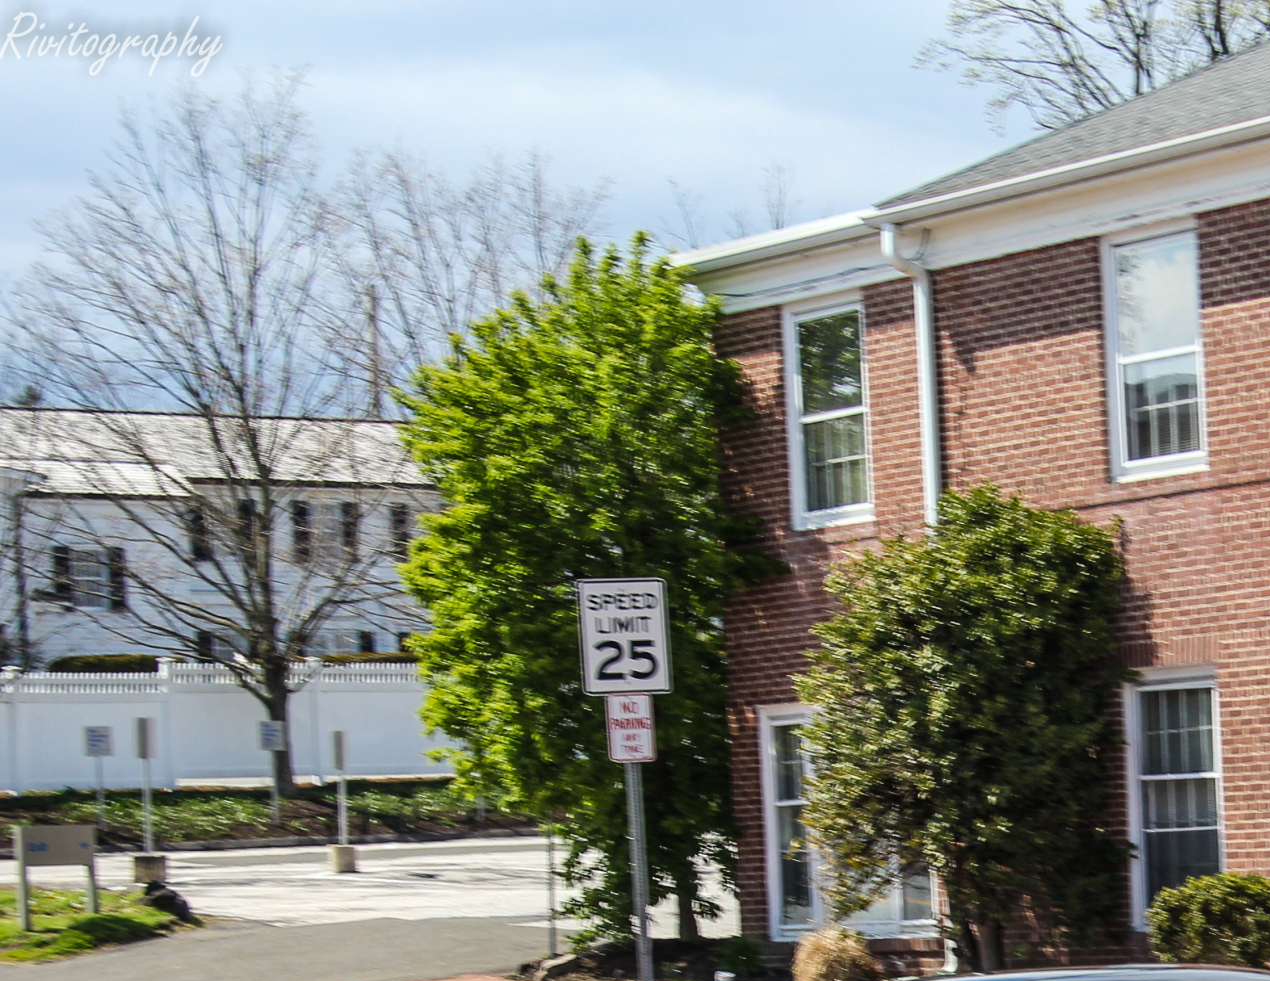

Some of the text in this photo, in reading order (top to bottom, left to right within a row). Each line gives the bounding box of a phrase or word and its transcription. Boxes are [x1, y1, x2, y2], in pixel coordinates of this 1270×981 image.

[586, 593, 659, 612] SPEED
[594, 616, 651, 634] LIMIT
[592, 640, 660, 680] 25
